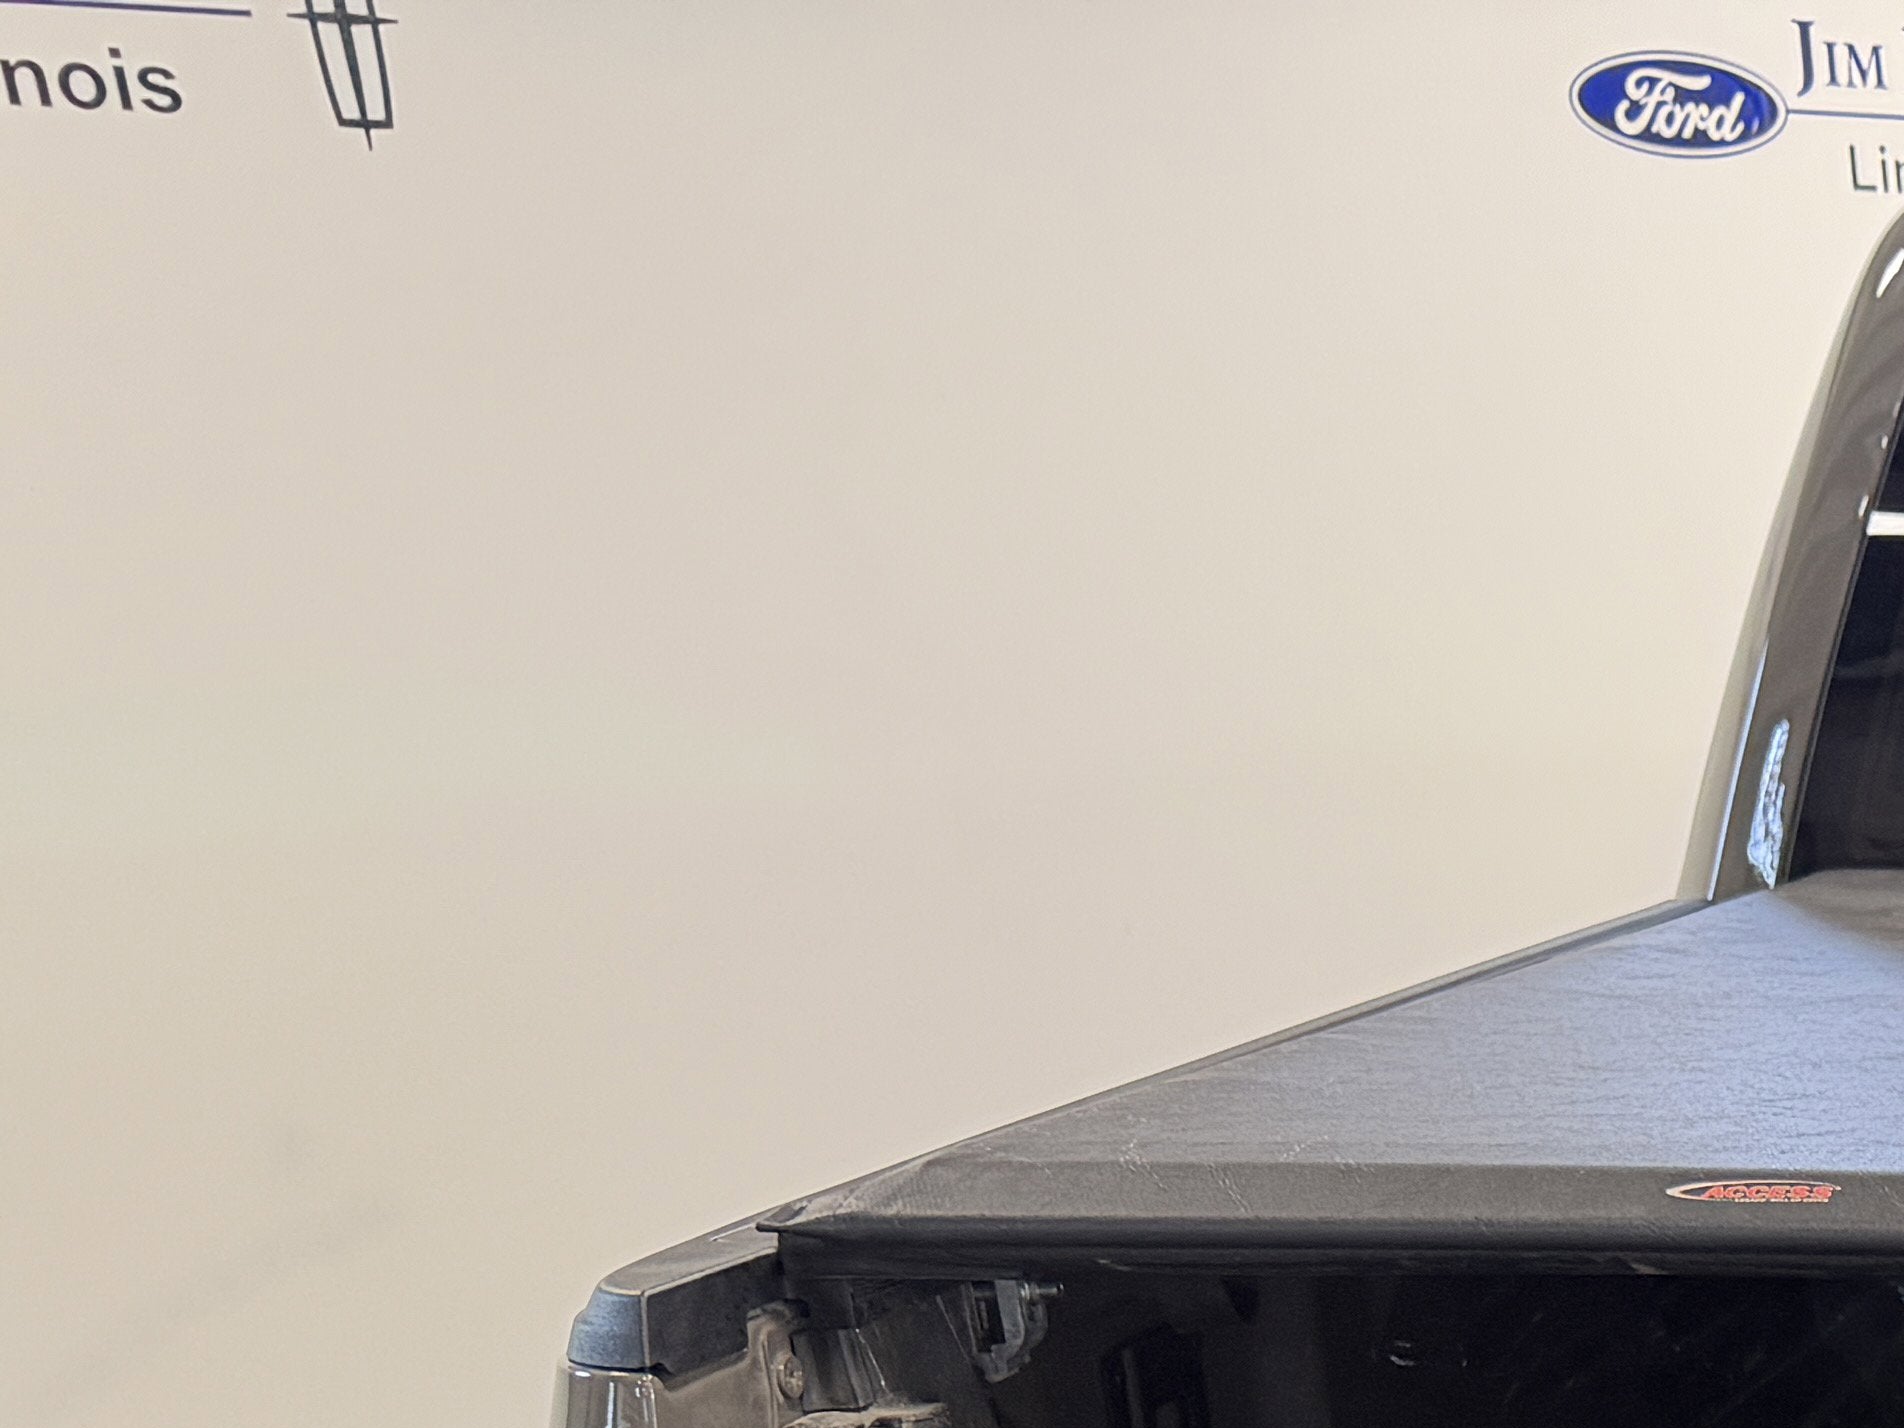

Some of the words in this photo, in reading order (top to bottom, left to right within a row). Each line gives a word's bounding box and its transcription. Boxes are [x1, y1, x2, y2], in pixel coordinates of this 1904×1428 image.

[1790, 18, 1888, 99] JIM
[1614, 67, 1746, 143] Ford
[1700, 1185, 1834, 1201] ACCESS
